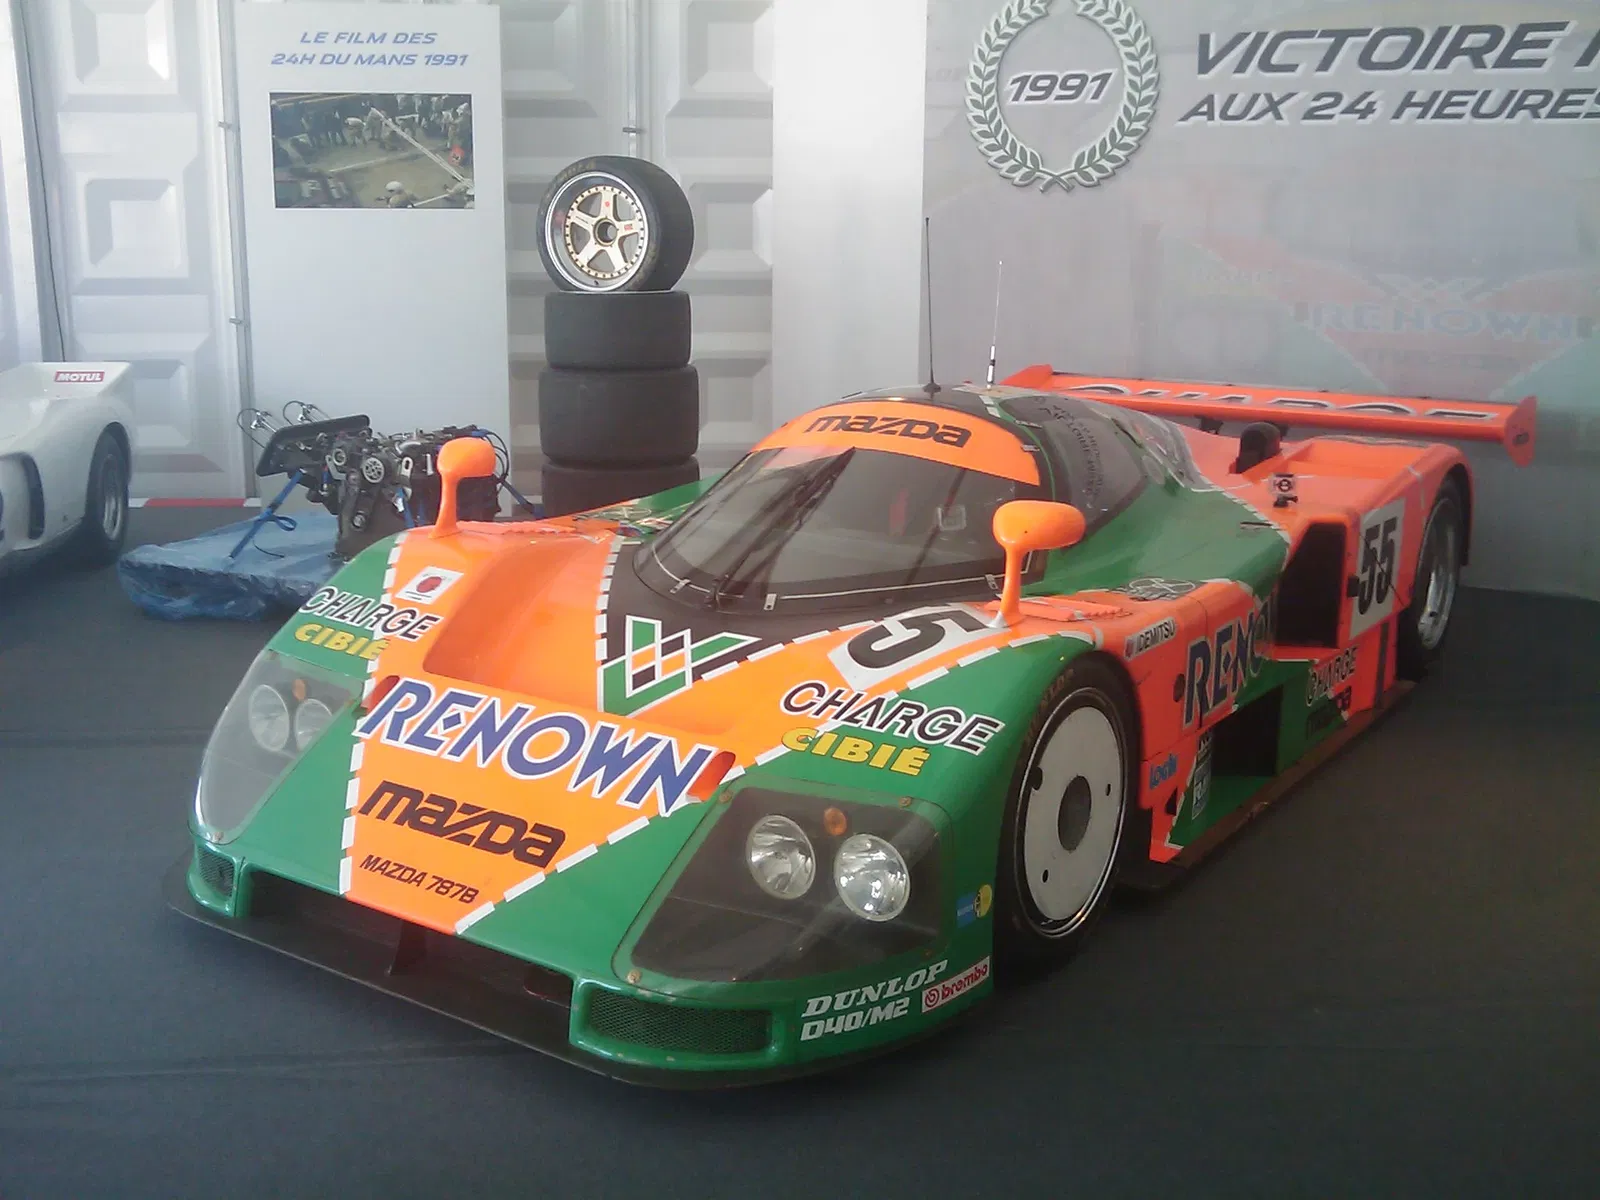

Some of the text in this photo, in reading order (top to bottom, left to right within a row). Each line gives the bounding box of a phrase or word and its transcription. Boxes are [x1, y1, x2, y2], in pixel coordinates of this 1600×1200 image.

[270, 53, 469, 66] 24H DU MANS 1991
[299, 31, 438, 44] LE FILM DES
[1196, 22, 1571, 75] VICTOIRE
[1006, 69, 1112, 104] 1991
[1178, 90, 1298, 124] AUX
[1300, 90, 1376, 122] 24
[56, 372, 103, 382] MOTUL
[1357, 516, 1399, 615] 55
[297, 588, 442, 643] CHARGE
[780, 680, 1005, 755] CHARGE
[353, 678, 716, 817] RENOWN
[780, 727, 932, 776] CIBIÉ
[359, 855, 479, 904] MAZDA 787B
[801, 959, 949, 1018] DUNLOP
[941, 963, 989, 1000] brembo
[800, 997, 910, 1041] D40/M2
